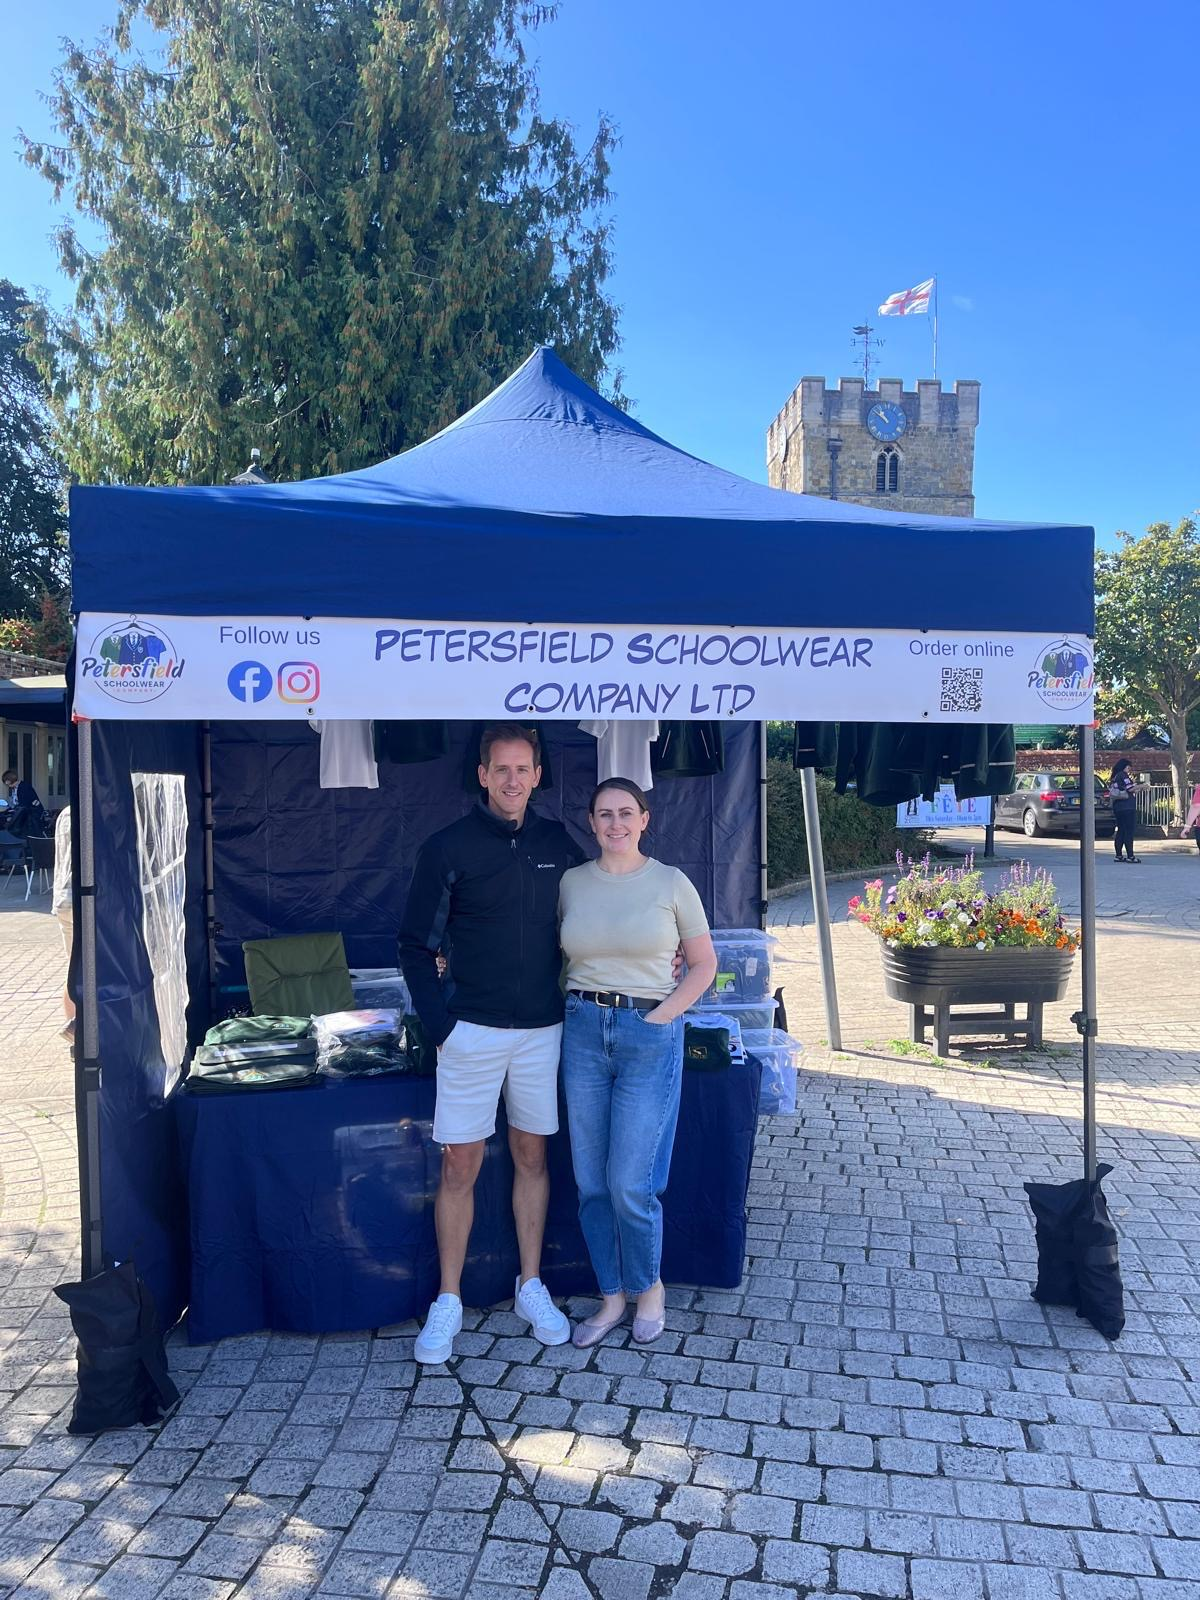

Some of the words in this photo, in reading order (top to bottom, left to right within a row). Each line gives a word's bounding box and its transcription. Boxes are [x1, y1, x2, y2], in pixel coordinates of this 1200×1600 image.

[220, 626, 289, 645] Follow
[296, 630, 321, 645] us
[375, 629, 614, 664] PETERSFIELD
[626, 633, 873, 667] SCHOOLWEAR
[909, 640, 958, 656] Order
[964, 641, 1014, 657] online
[82, 657, 185, 678] Petersfield
[1027, 671, 1094, 689] Petersfiel
[505, 682, 680, 713] COMPANY
[690, 684, 755, 714] LTD
